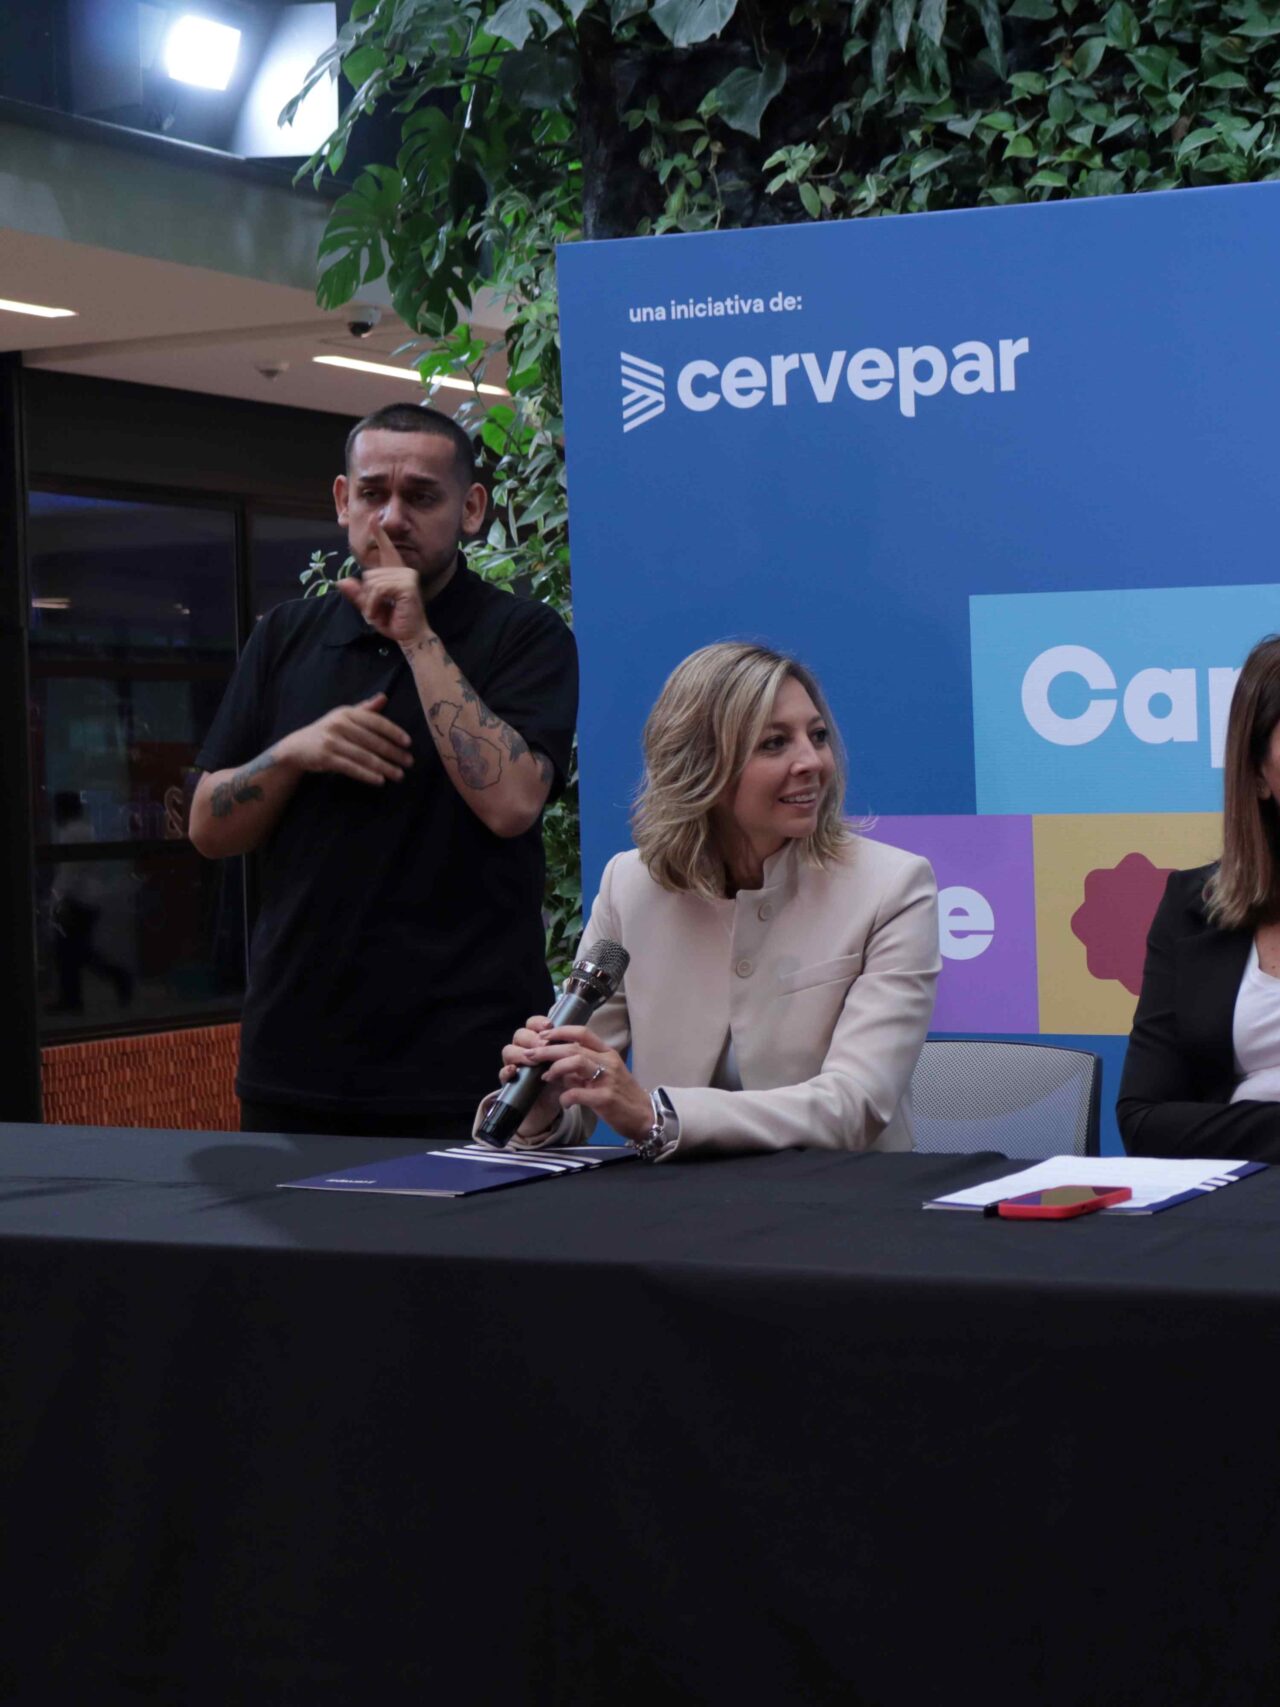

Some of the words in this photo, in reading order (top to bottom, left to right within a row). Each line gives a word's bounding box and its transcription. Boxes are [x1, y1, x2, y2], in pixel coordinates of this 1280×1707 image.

[628, 306, 667, 323] una
[670, 296, 765, 320] iniciativa
[769, 291, 803, 312] de:
[677, 337, 1030, 418] cervepar
